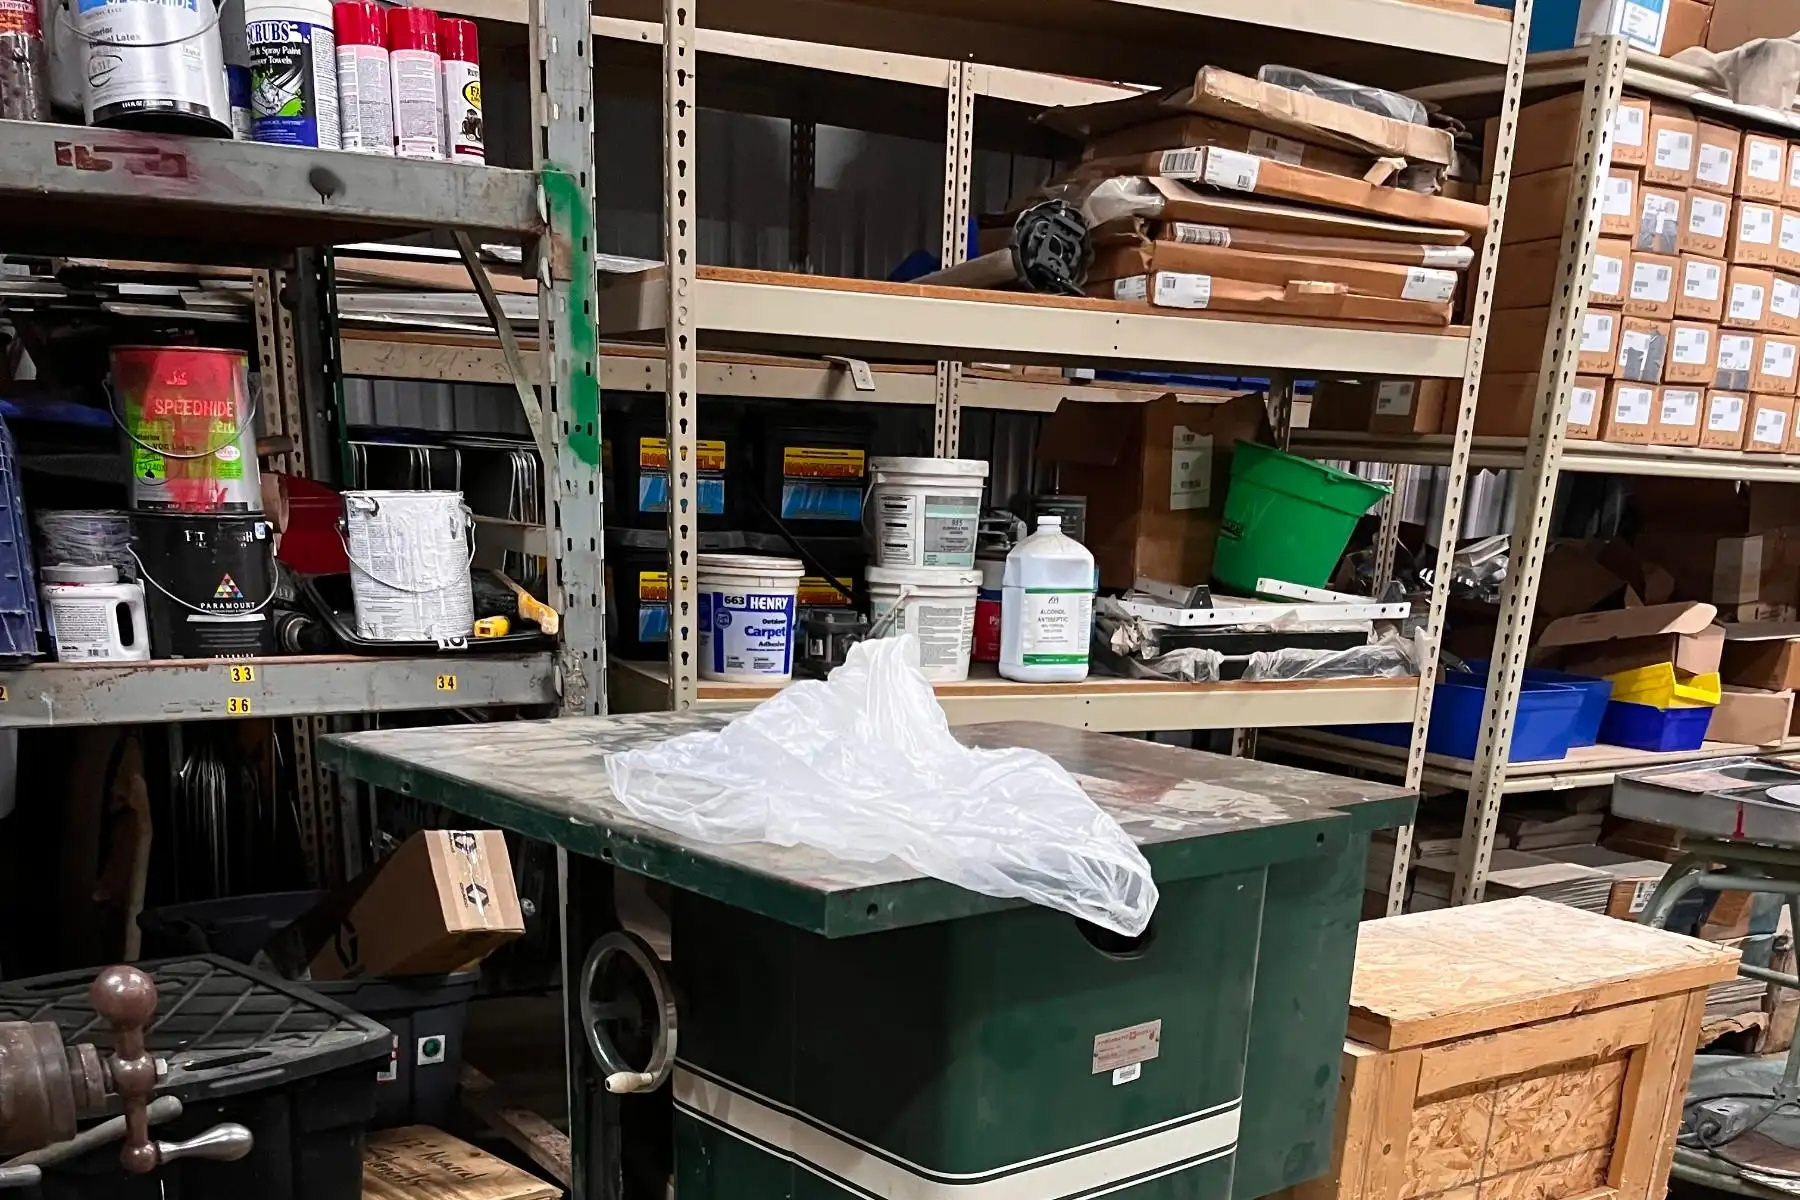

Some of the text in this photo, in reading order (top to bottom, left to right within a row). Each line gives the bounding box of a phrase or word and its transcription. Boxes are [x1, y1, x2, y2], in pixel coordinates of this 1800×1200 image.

[261, 46, 281, 56] Spray
[268, 55, 292, 65] Towels
[154, 398, 235, 418] SPEEDHIDE
[724, 595, 745, 606] 663
[749, 596, 789, 611] HENRY
[744, 625, 786, 640] Carpet
[232, 667, 252, 681] 33
[438, 675, 454, 689] 34
[229, 698, 249, 712] 36
